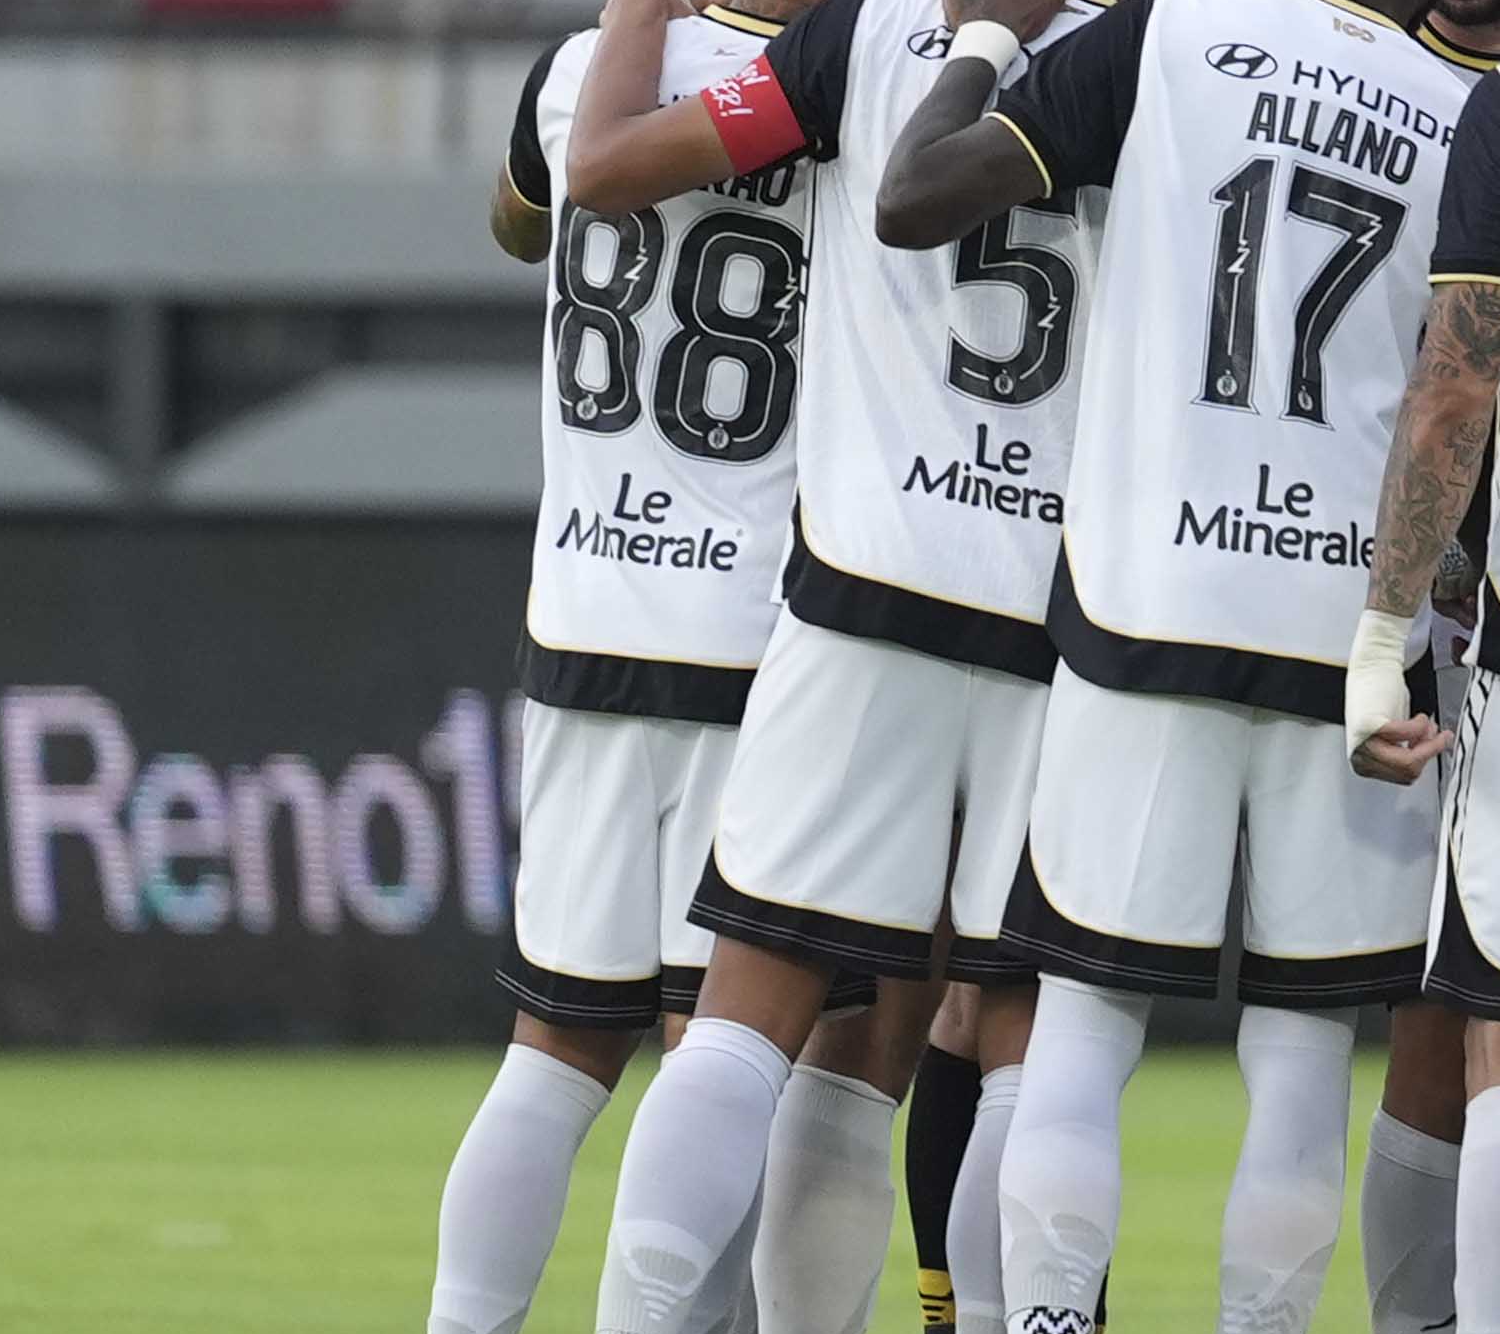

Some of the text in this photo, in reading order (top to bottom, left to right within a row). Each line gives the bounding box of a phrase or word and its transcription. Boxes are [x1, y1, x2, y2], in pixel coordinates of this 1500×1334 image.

[1246, 92, 1418, 185] ALLANO
[552, 197, 806, 466] 88
[944, 194, 1079, 409] 5
[1191, 154, 1411, 432] 17
[902, 454, 1066, 525] Minera
[975, 422, 1032, 475] Le
[612, 472, 672, 524] Le
[1256, 464, 1314, 518] Le
